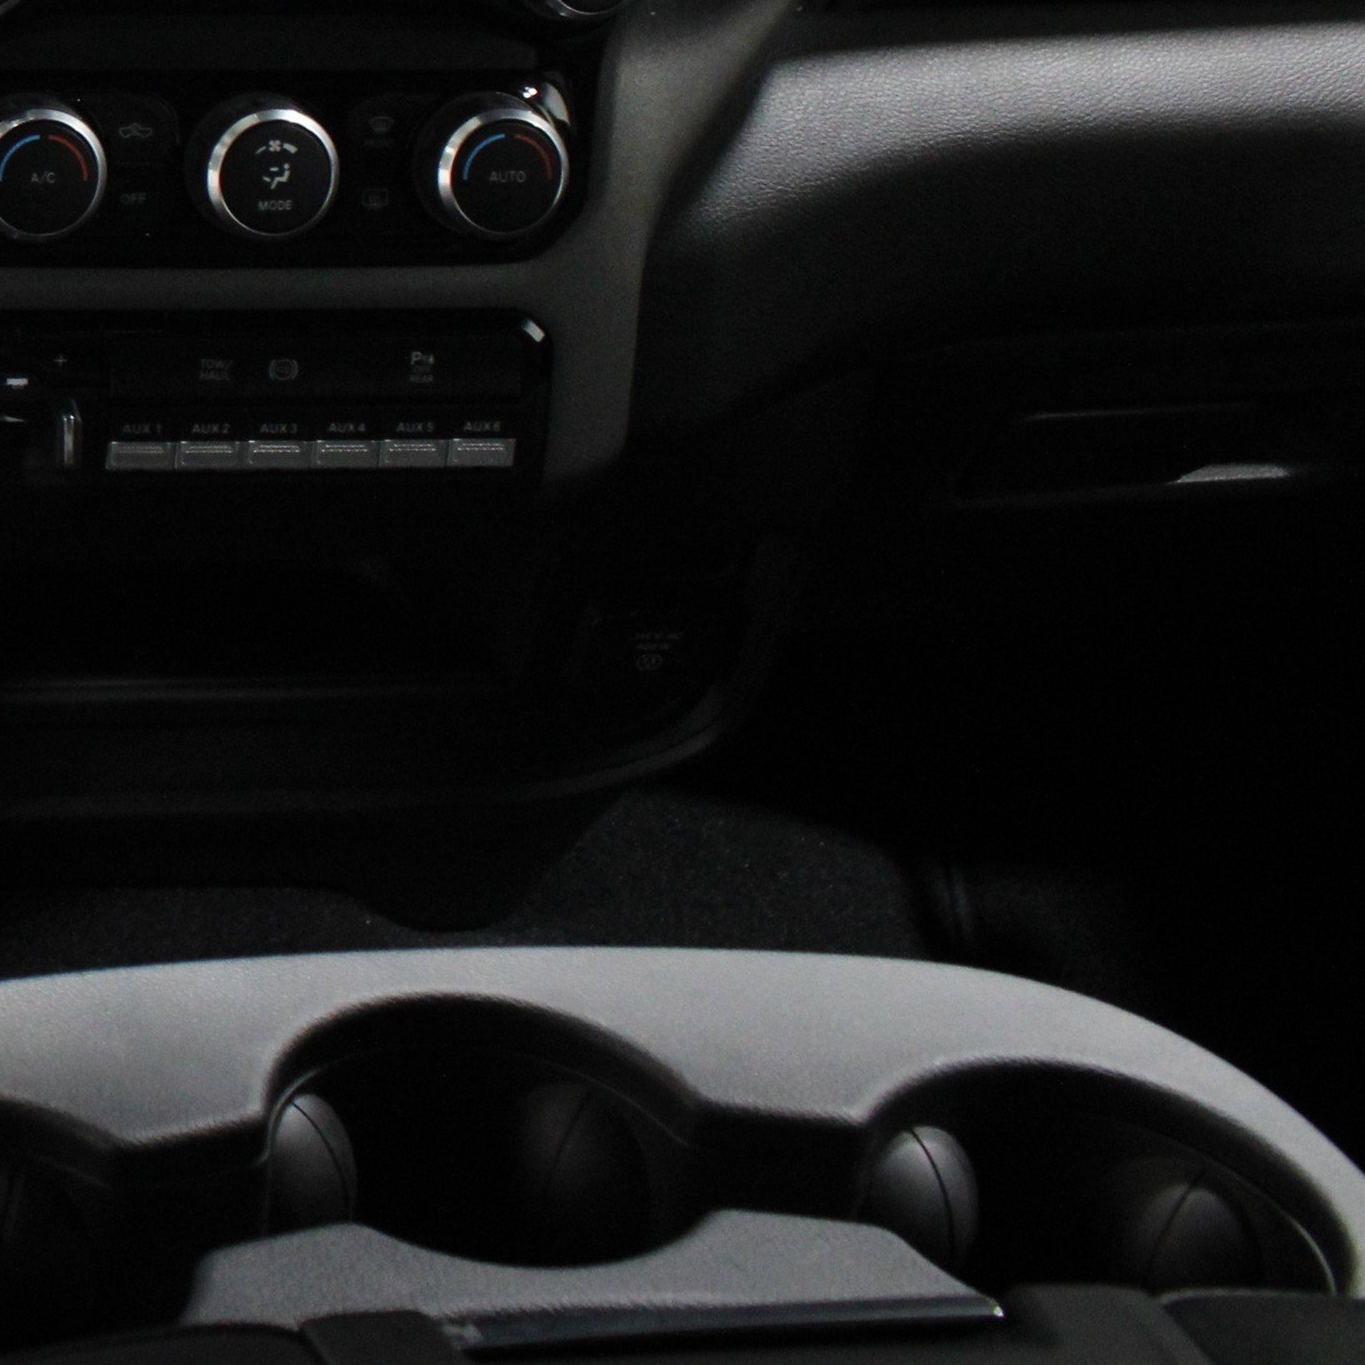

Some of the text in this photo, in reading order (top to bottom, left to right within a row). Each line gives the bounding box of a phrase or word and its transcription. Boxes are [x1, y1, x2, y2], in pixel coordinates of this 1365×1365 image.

[30, 172, 56, 184] A/C
[489, 170, 527, 183] AUTO
[257, 200, 294, 212] MODE
[123, 423, 154, 434] AUX
[191, 423, 220, 434] AUX
[259, 423, 289, 434] AUX
[328, 422, 356, 433] AUX
[395, 421, 425, 433] AUX
[463, 421, 492, 433] AUX
